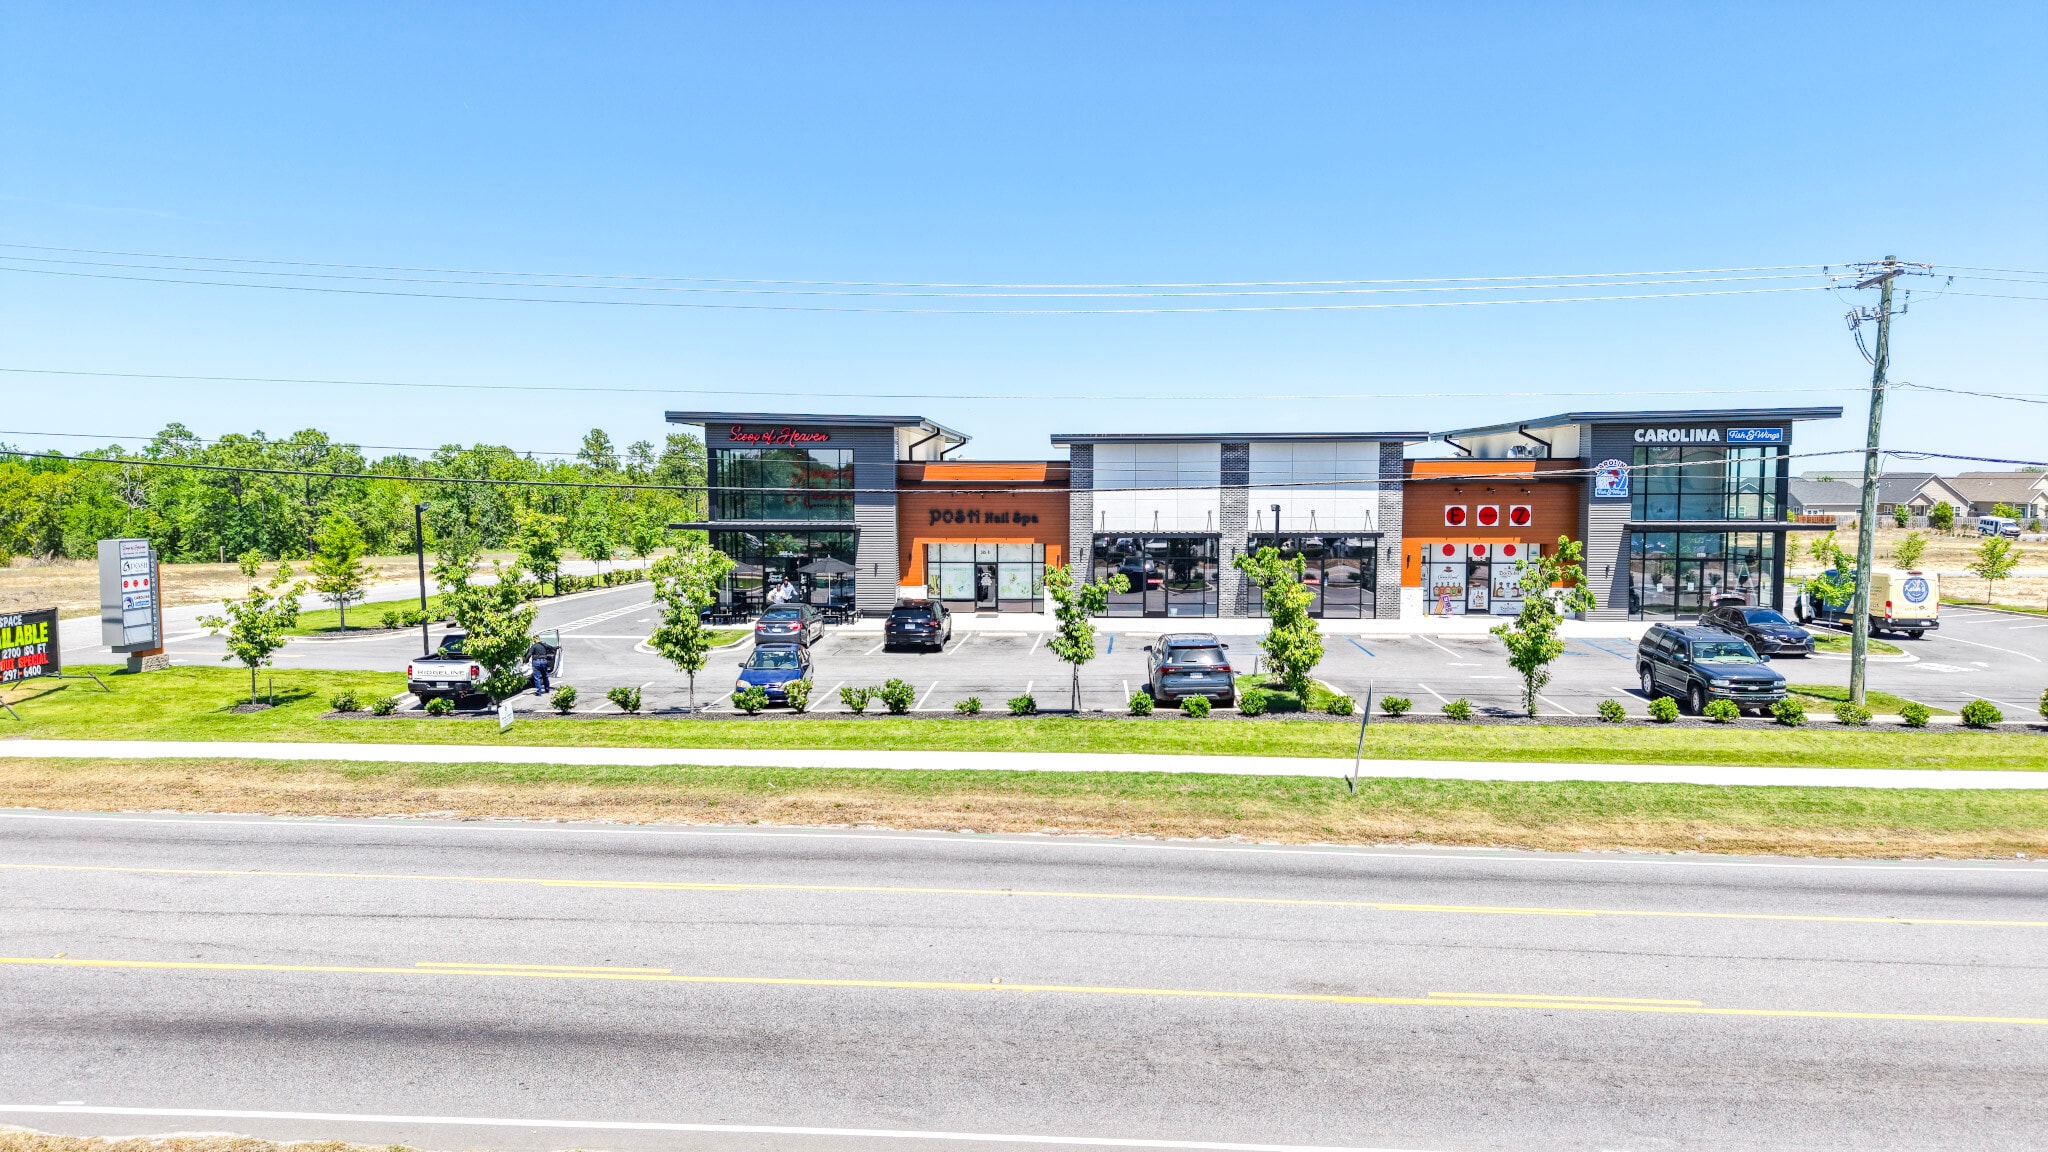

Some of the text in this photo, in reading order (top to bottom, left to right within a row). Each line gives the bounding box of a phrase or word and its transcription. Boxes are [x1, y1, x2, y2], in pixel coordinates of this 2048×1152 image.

[728, 423, 829, 448] Scoop of Heaven
[1634, 428, 1720, 442] CAROLINA
[984, 512, 1009, 524] Nail
[1012, 511, 1039, 527] Spa
[0, 615, 23, 628] SPACE
[0, 621, 49, 649] ILABLE
[2, 643, 47, 659] 2700 SQ FT
[18, 653, 49, 668] SPECIAL
